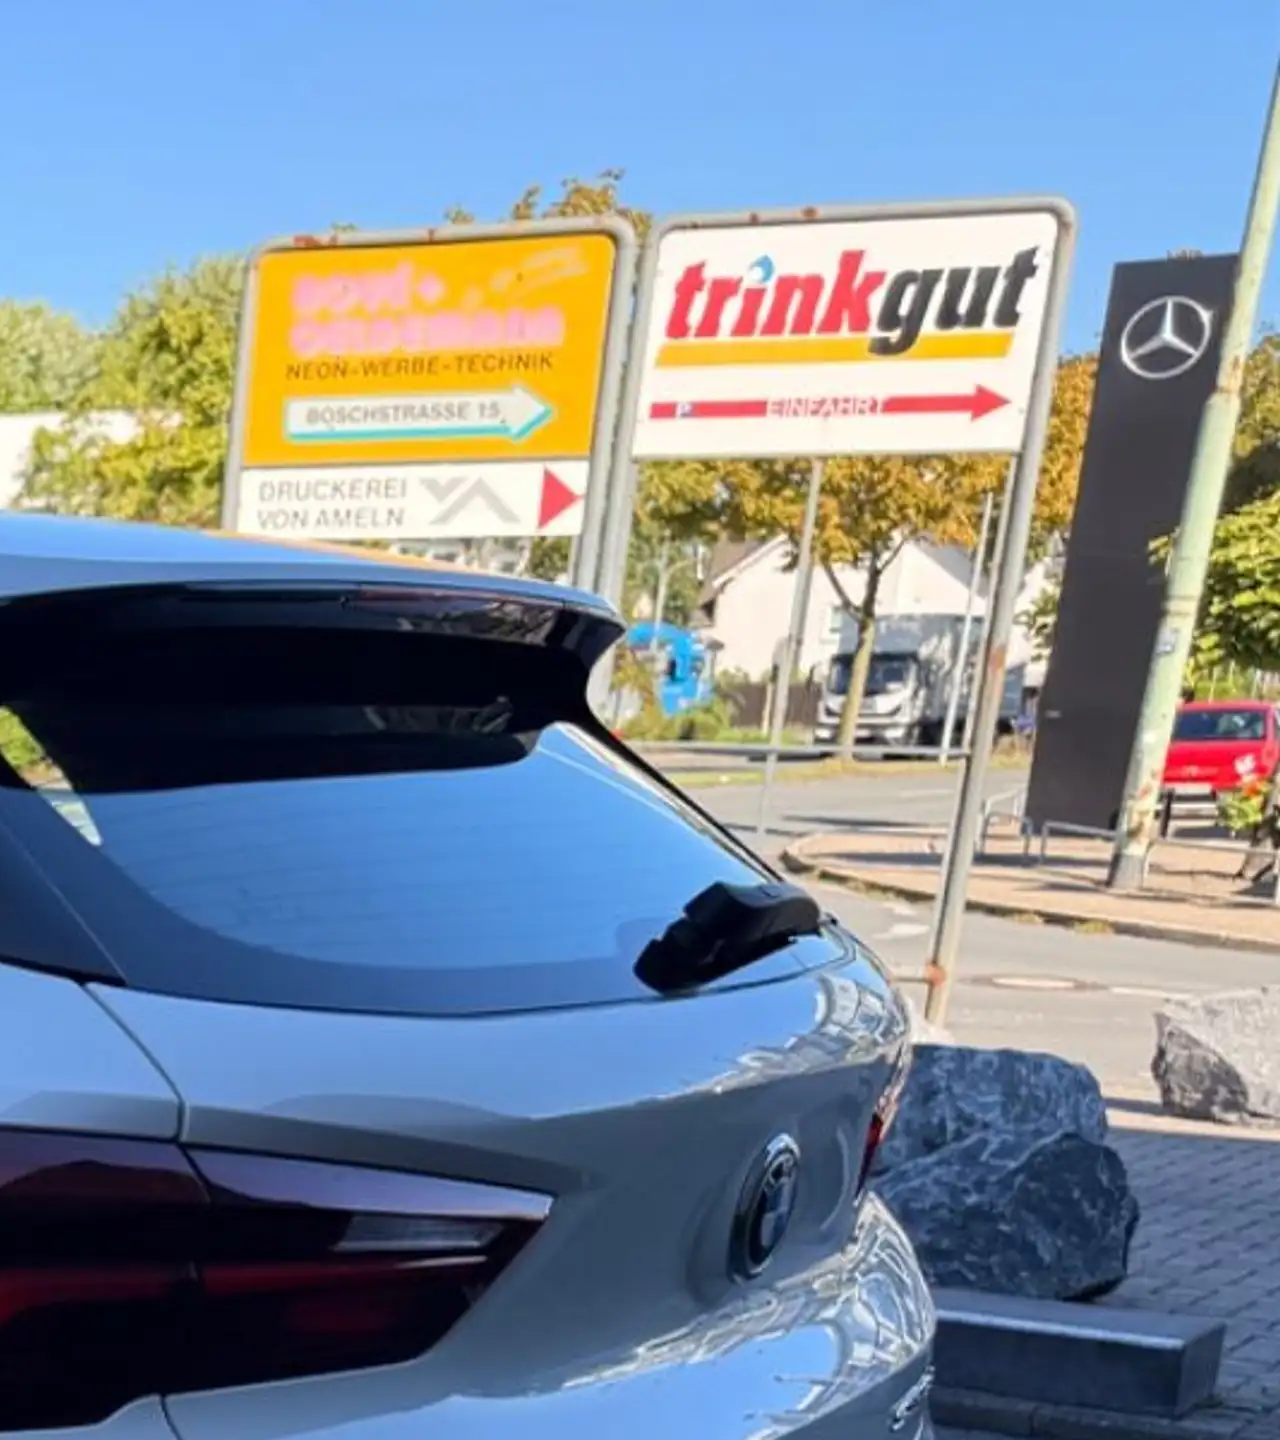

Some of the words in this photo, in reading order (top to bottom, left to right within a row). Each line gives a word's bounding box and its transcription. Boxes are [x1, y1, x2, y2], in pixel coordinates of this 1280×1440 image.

[664, 246, 1039, 356] trinkgut
[306, 402, 473, 425] BOSCHSTRASSE
[767, 394, 885, 419] EINFAHRT
[259, 478, 407, 503] DRUCKEREI
[257, 508, 309, 530] VON
[316, 506, 406, 528] AMELN
